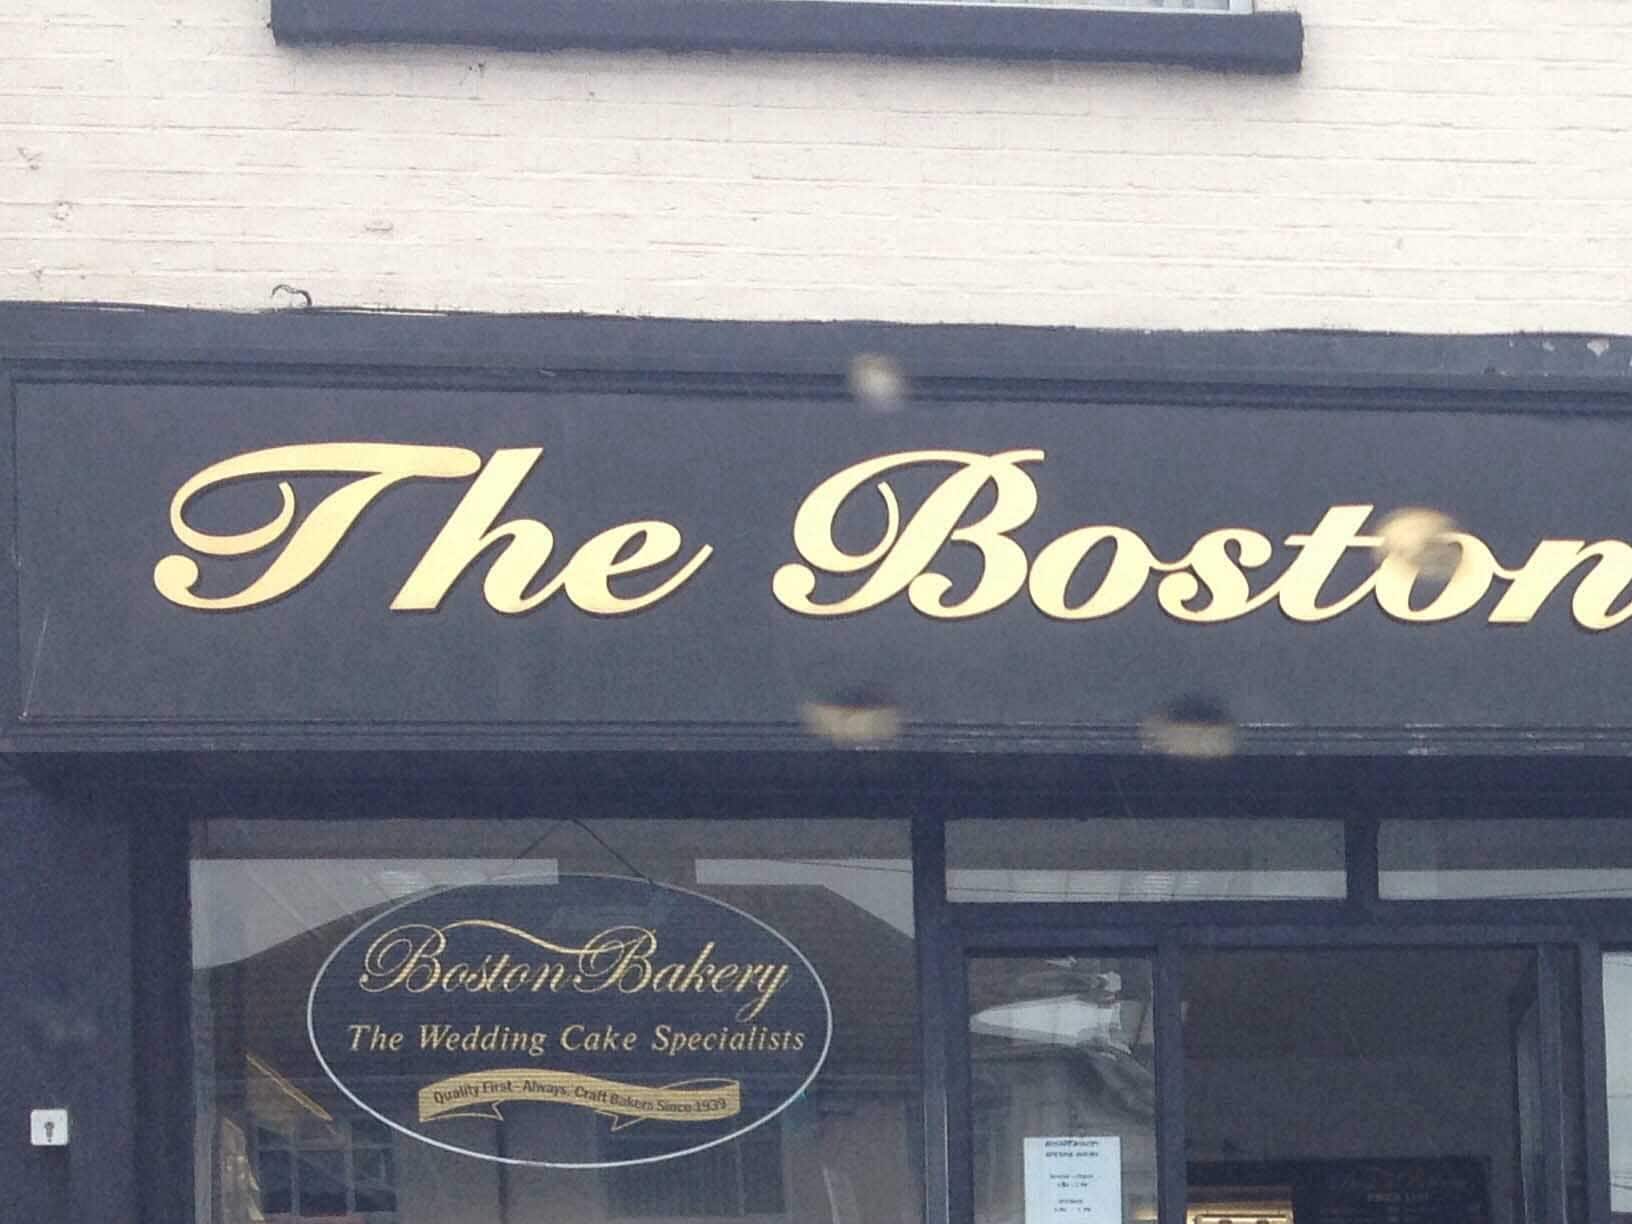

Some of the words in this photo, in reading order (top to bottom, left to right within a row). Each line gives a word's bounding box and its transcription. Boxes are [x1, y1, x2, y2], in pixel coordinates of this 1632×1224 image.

[154, 442, 714, 614] The
[359, 919, 572, 993] Boston
[572, 924, 791, 1023] Bakery
[348, 1024, 405, 1052] The
[418, 1024, 548, 1057] Wedding
[560, 1024, 638, 1052] Cake
[651, 1024, 806, 1056] Specialists
[433, 1084, 480, 1105] Quality
[482, 1080, 512, 1094] First
[574, 1085, 608, 1102] Craft
[609, 1093, 655, 1112] Bakers
[656, 1098, 692, 1113] Since
